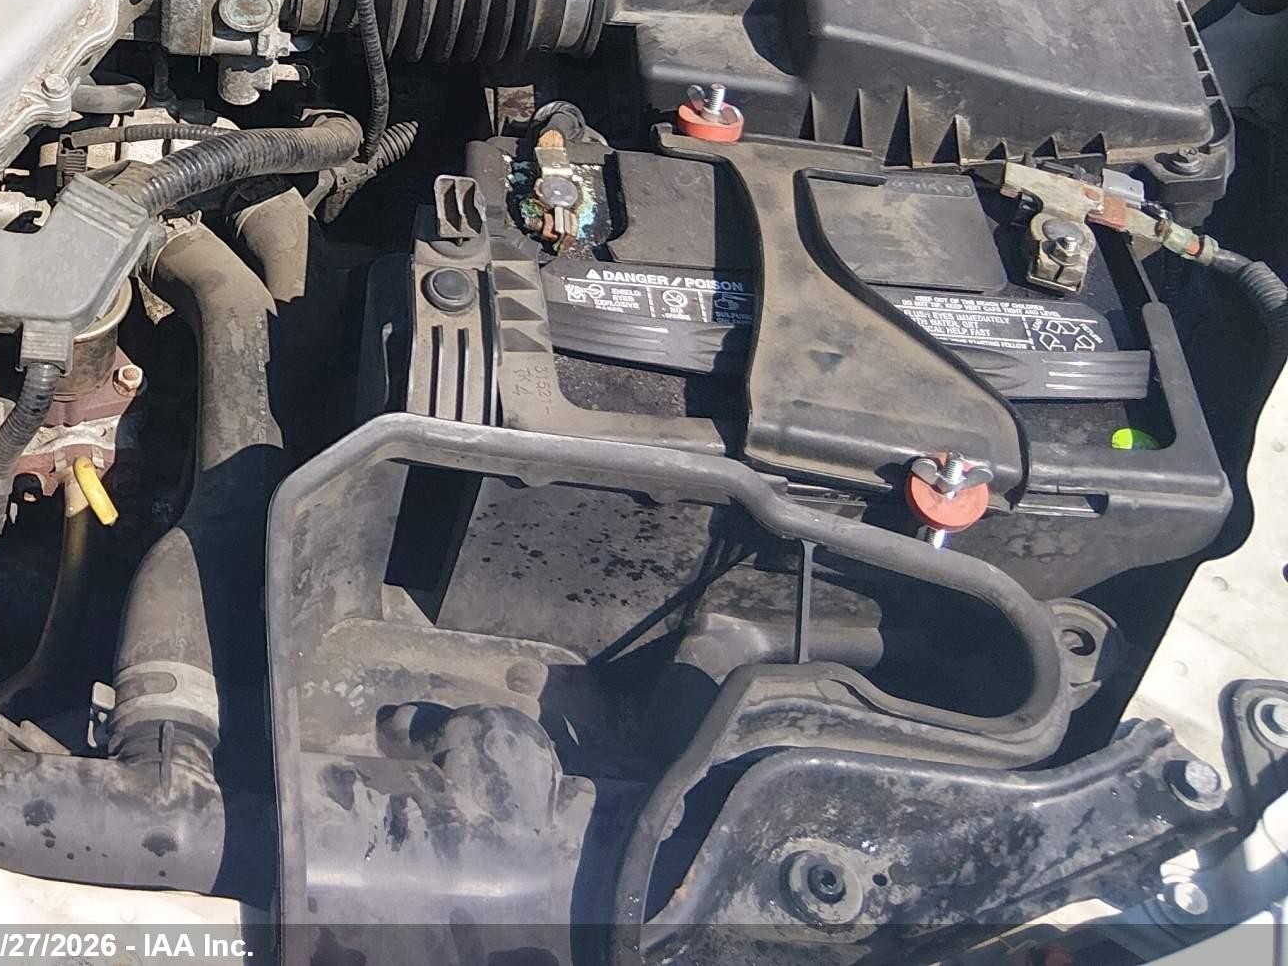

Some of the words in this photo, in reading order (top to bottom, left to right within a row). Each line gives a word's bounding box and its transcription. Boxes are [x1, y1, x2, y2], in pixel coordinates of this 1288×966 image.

[602, 270, 669, 286] DANGER
[671, 276, 683, 286] /
[684, 278, 744, 292] POISON
[932, 311, 954, 320] EYES
[955, 313, 1010, 324] IMMEDIATELY
[969, 328, 990, 336] FAST
